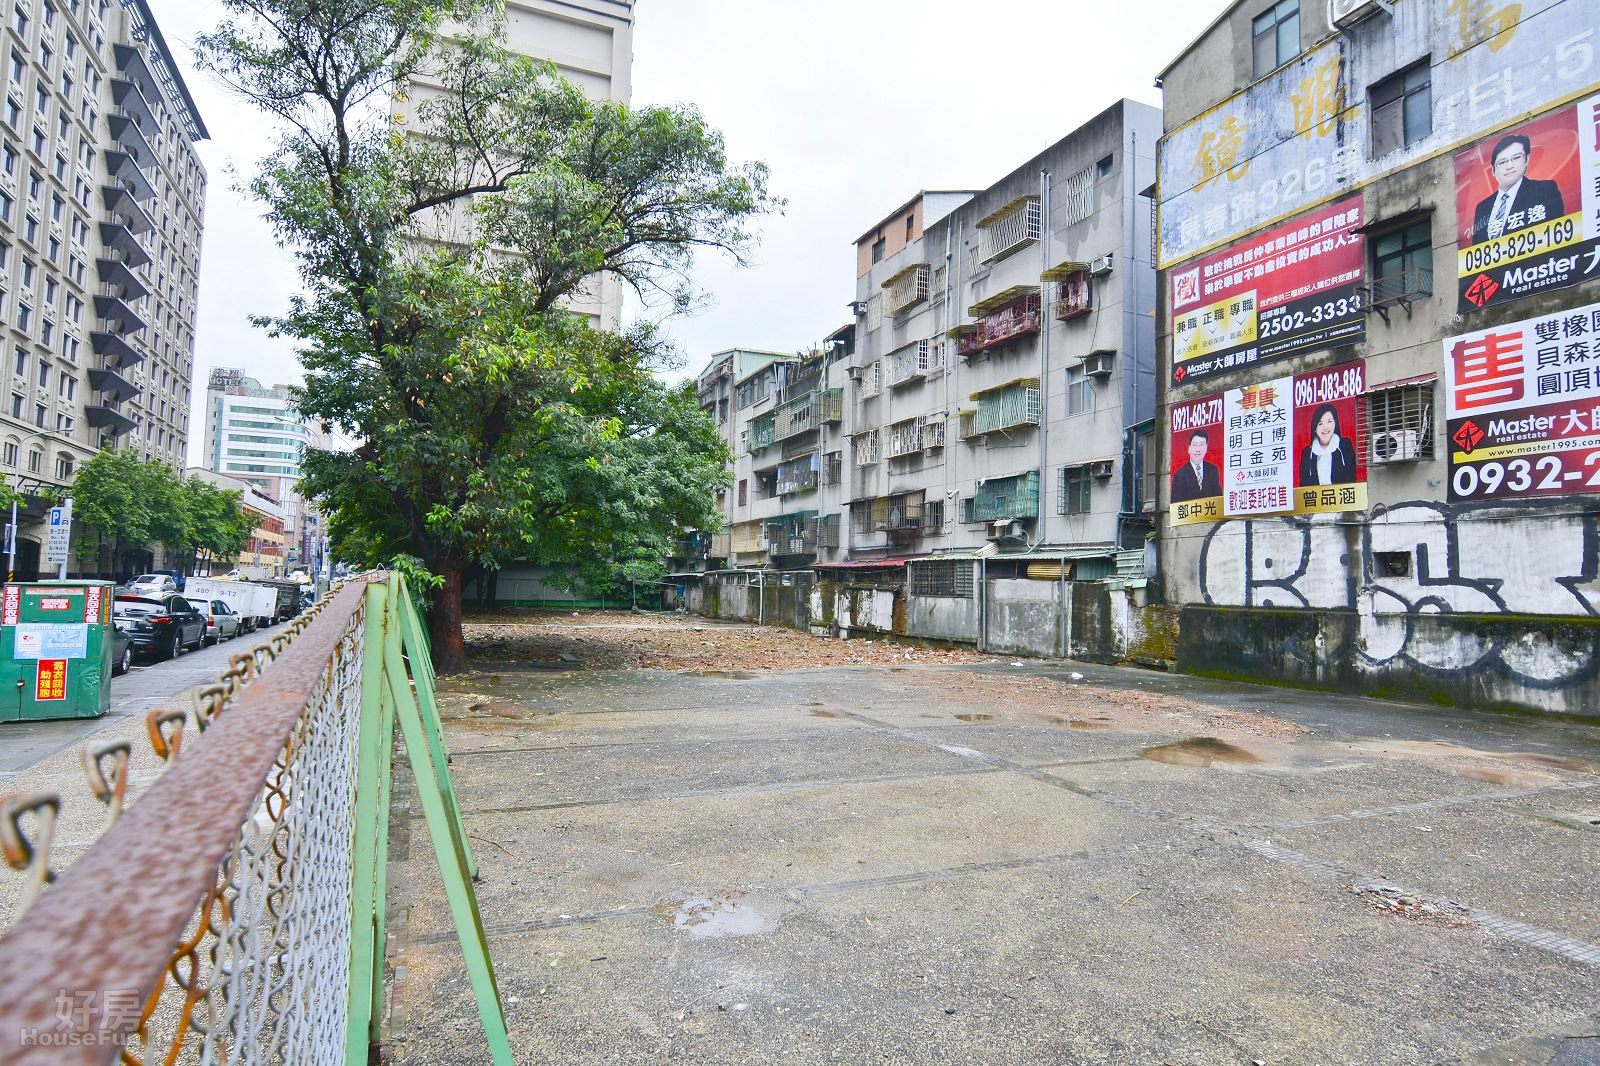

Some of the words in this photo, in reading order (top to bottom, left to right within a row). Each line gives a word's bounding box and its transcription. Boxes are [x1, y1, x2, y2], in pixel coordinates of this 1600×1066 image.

[1487, 204, 1546, 236] 李宏逸
[1466, 218, 1574, 272] 0983-829-169
[1503, 254, 1579, 288] Master
[1511, 282, 1531, 294] real
[1534, 273, 1568, 289] estate
[1177, 274, 1197, 302] 徵
[1203, 307, 1225, 325] 正職
[1230, 298, 1254, 316] 專職
[1260, 295, 1360, 339] 2502-3333
[1187, 361, 1212, 375] Master
[1214, 347, 1258, 371] 大師房屋
[1450, 330, 1525, 412] 售
[1295, 367, 1362, 407] 0961-083-886
[1538, 366, 1600, 397] 圓頂
[1242, 387, 1274, 410] 專售
[1173, 398, 1223, 431] 0921-605-778
[1230, 407, 1286, 431] 貝森朵夫
[1488, 413, 1557, 438] Master
[1229, 426, 1287, 449] 明日博
[1496, 434, 1515, 443] real
[1517, 431, 1548, 441] estate
[1229, 446, 1287, 468] 白金苑
[1246, 467, 1279, 479] 大師房屋
[1229, 485, 1288, 511] 歡迎委託租售
[1303, 487, 1356, 508] 曾品涵
[53, 511, 60, 523] P
[1178, 502, 1217, 520] 鄧中光
[53, 661, 65, 697] 舊衣回收
